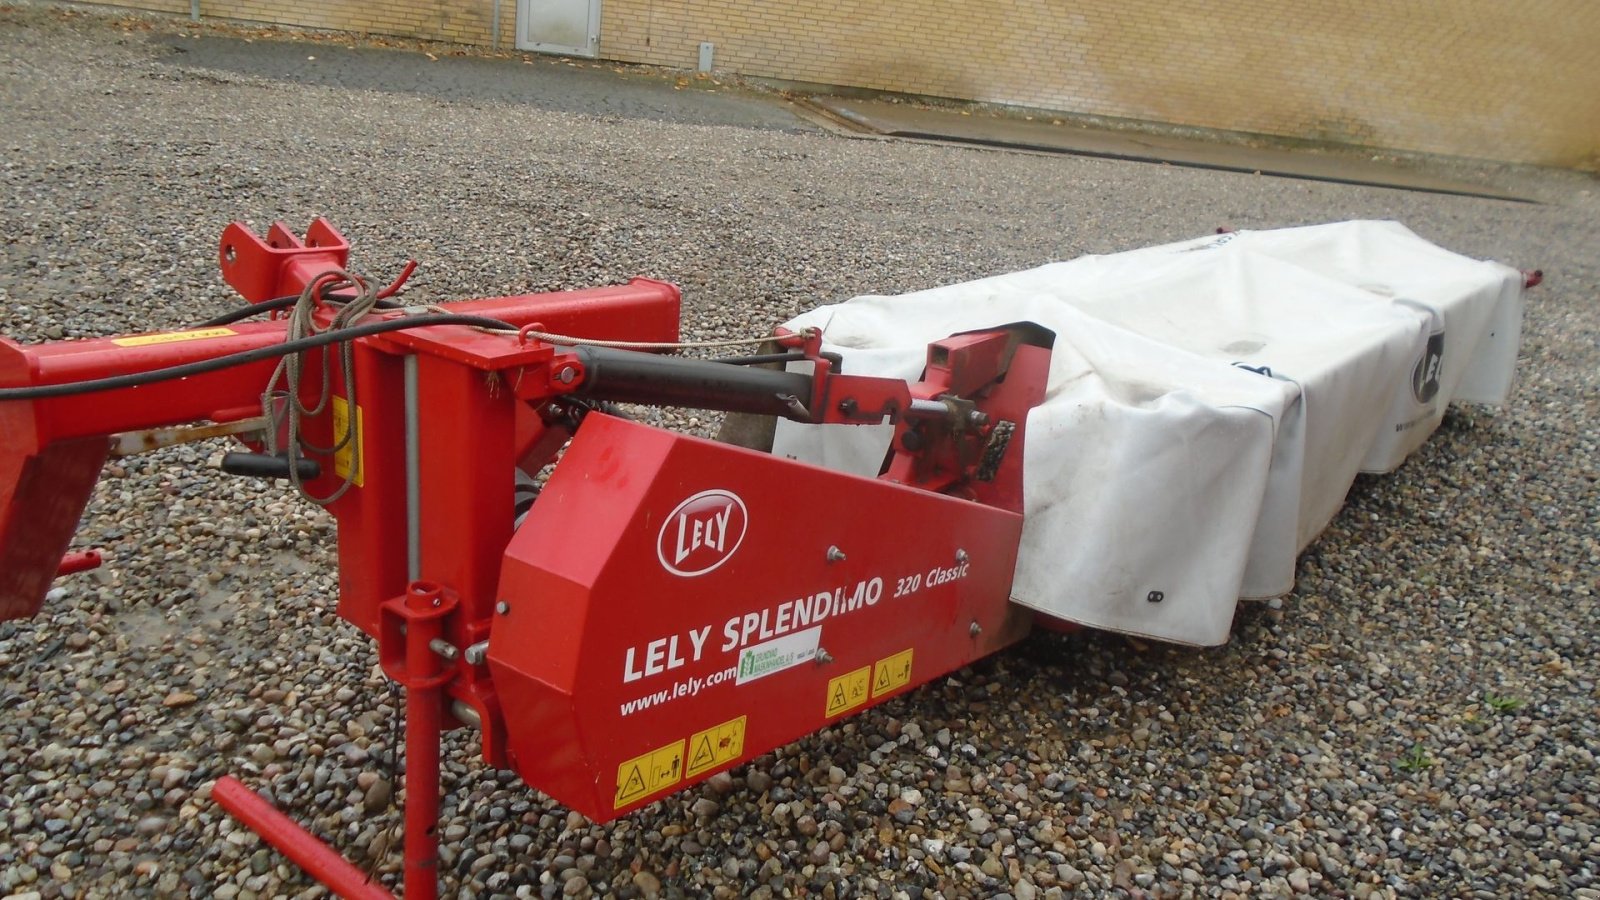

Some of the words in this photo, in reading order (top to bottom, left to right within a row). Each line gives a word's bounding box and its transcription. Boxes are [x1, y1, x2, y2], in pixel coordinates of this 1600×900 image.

[675, 503, 733, 565] LELY
[623, 624, 712, 684] LELY
[721, 576, 884, 653] SPLENDIMO
[893, 573, 922, 599] 320
[925, 560, 970, 589] Classic
[620, 666, 738, 717] www.lely.com
